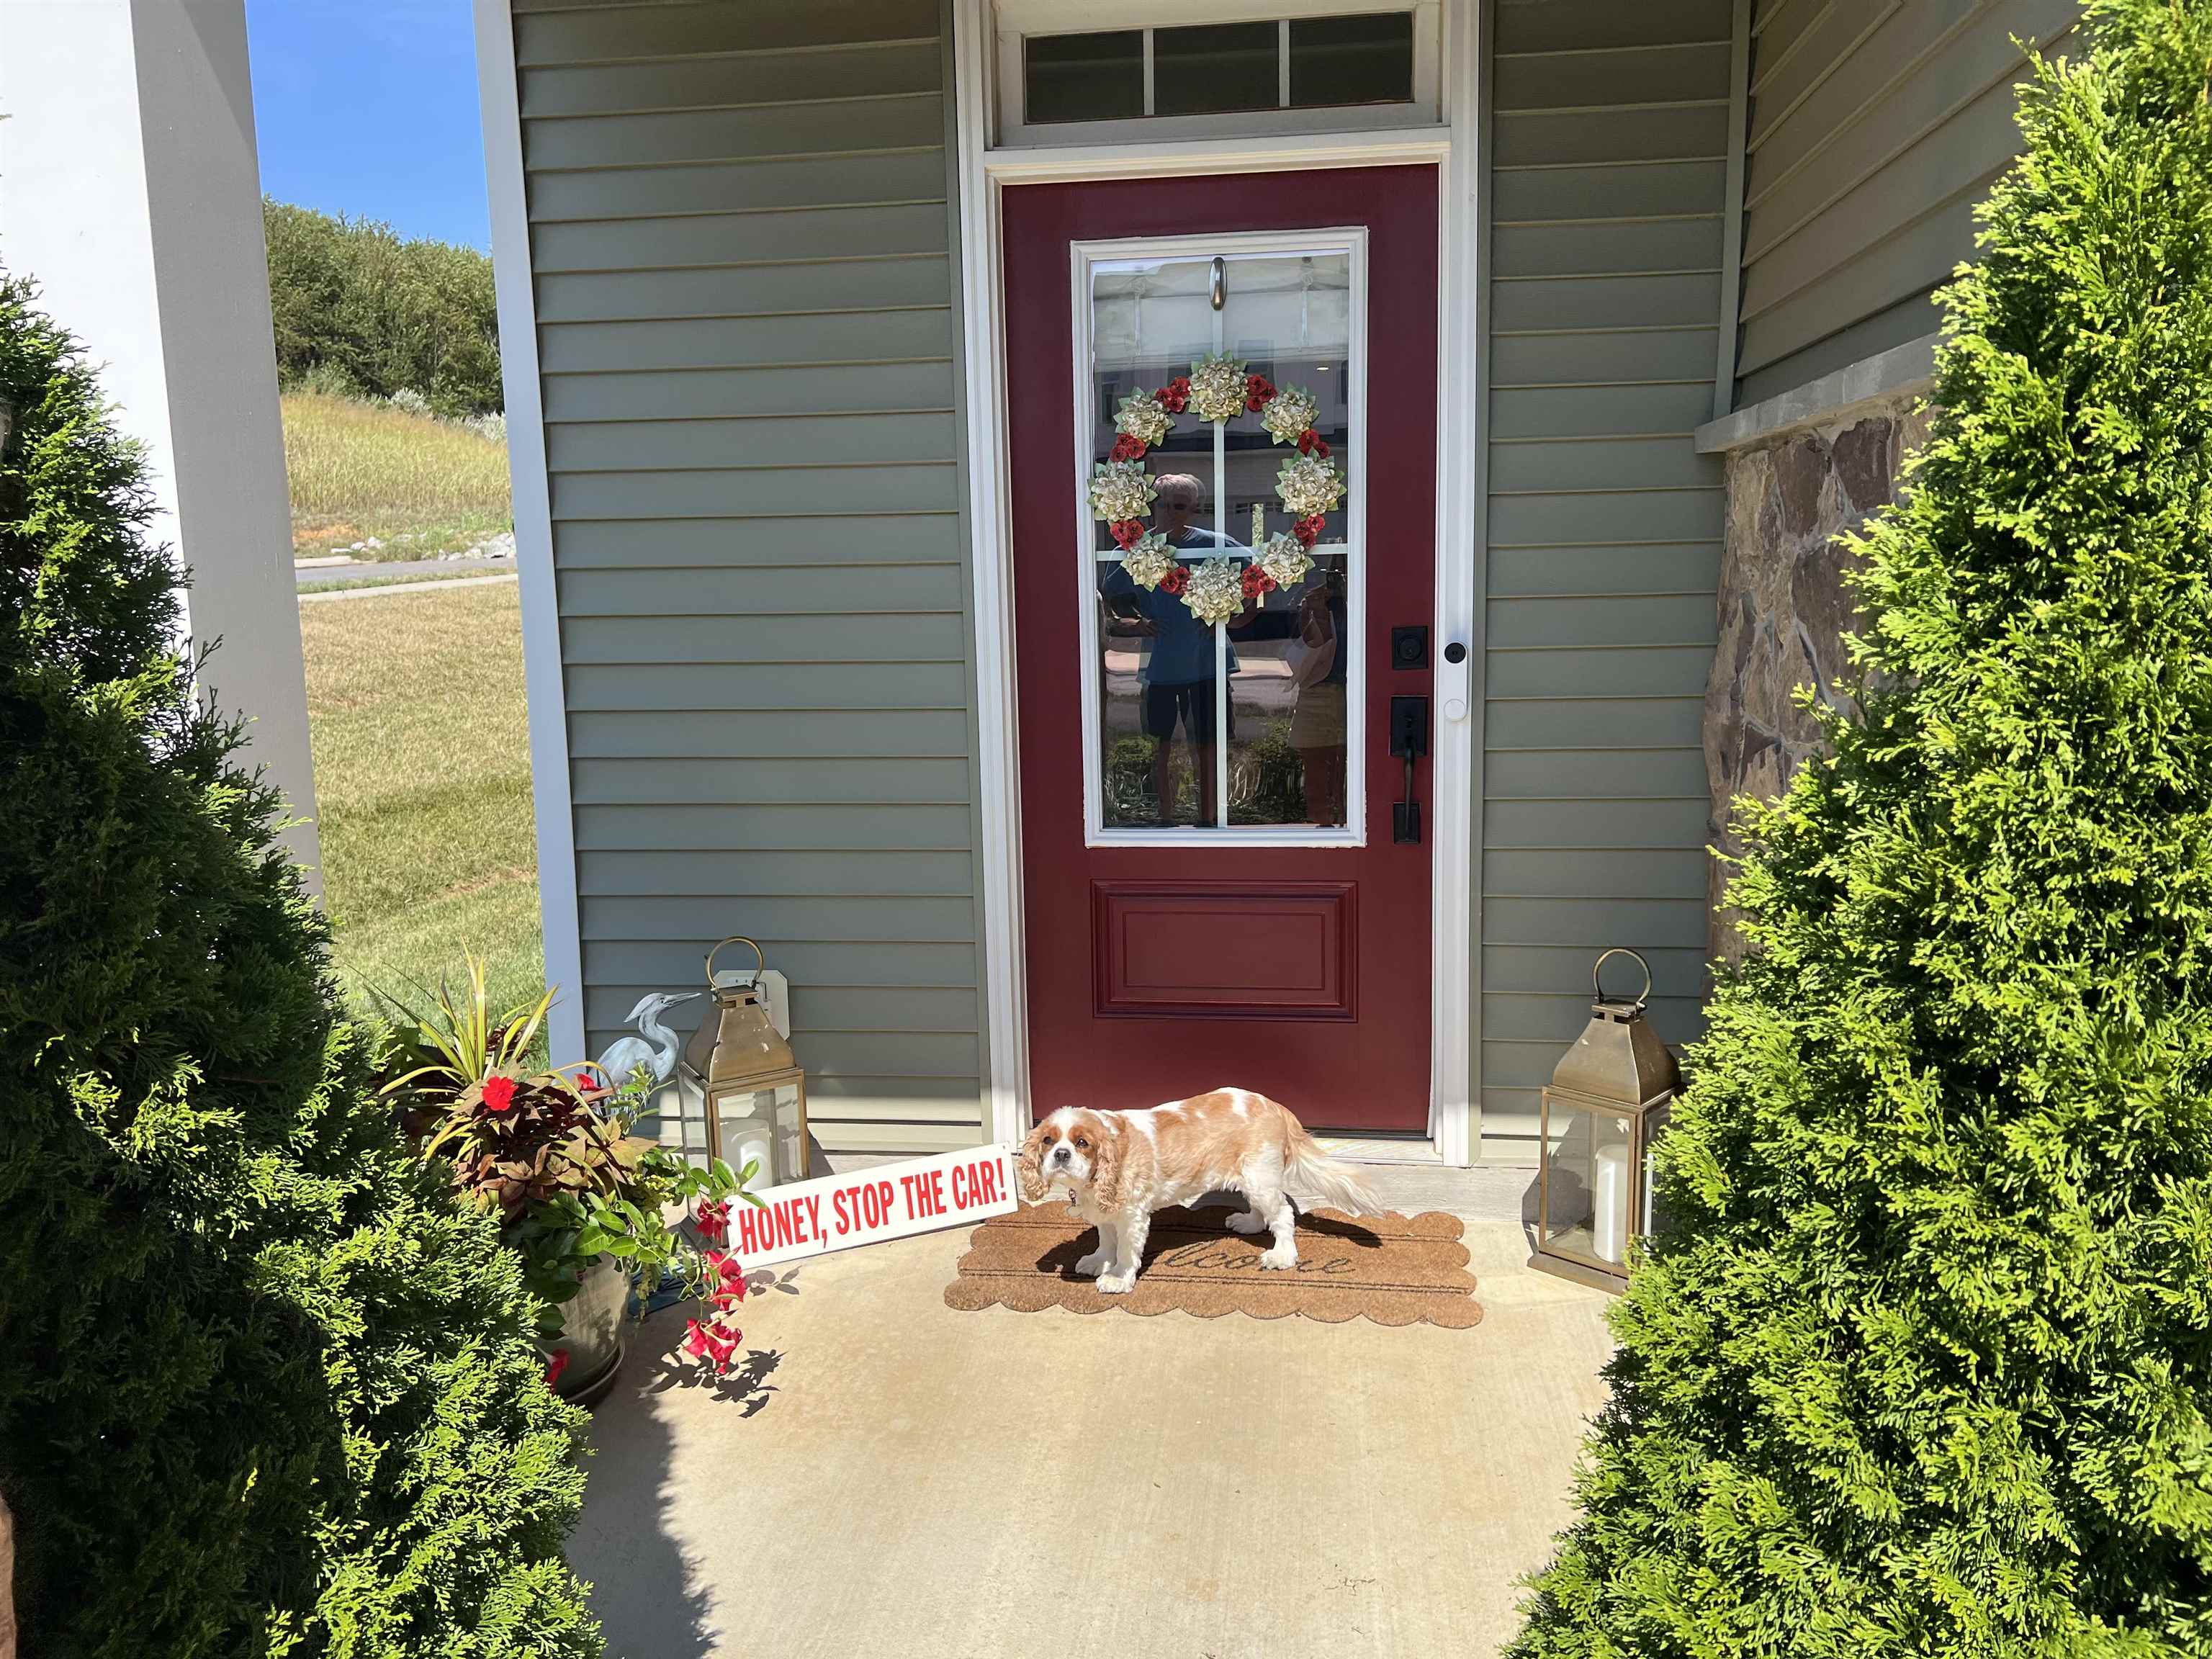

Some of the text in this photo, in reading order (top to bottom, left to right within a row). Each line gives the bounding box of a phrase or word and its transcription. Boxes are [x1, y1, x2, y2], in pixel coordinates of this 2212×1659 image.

[738, 1158, 1007, 1255] HONEY, STOP THE CAR!
